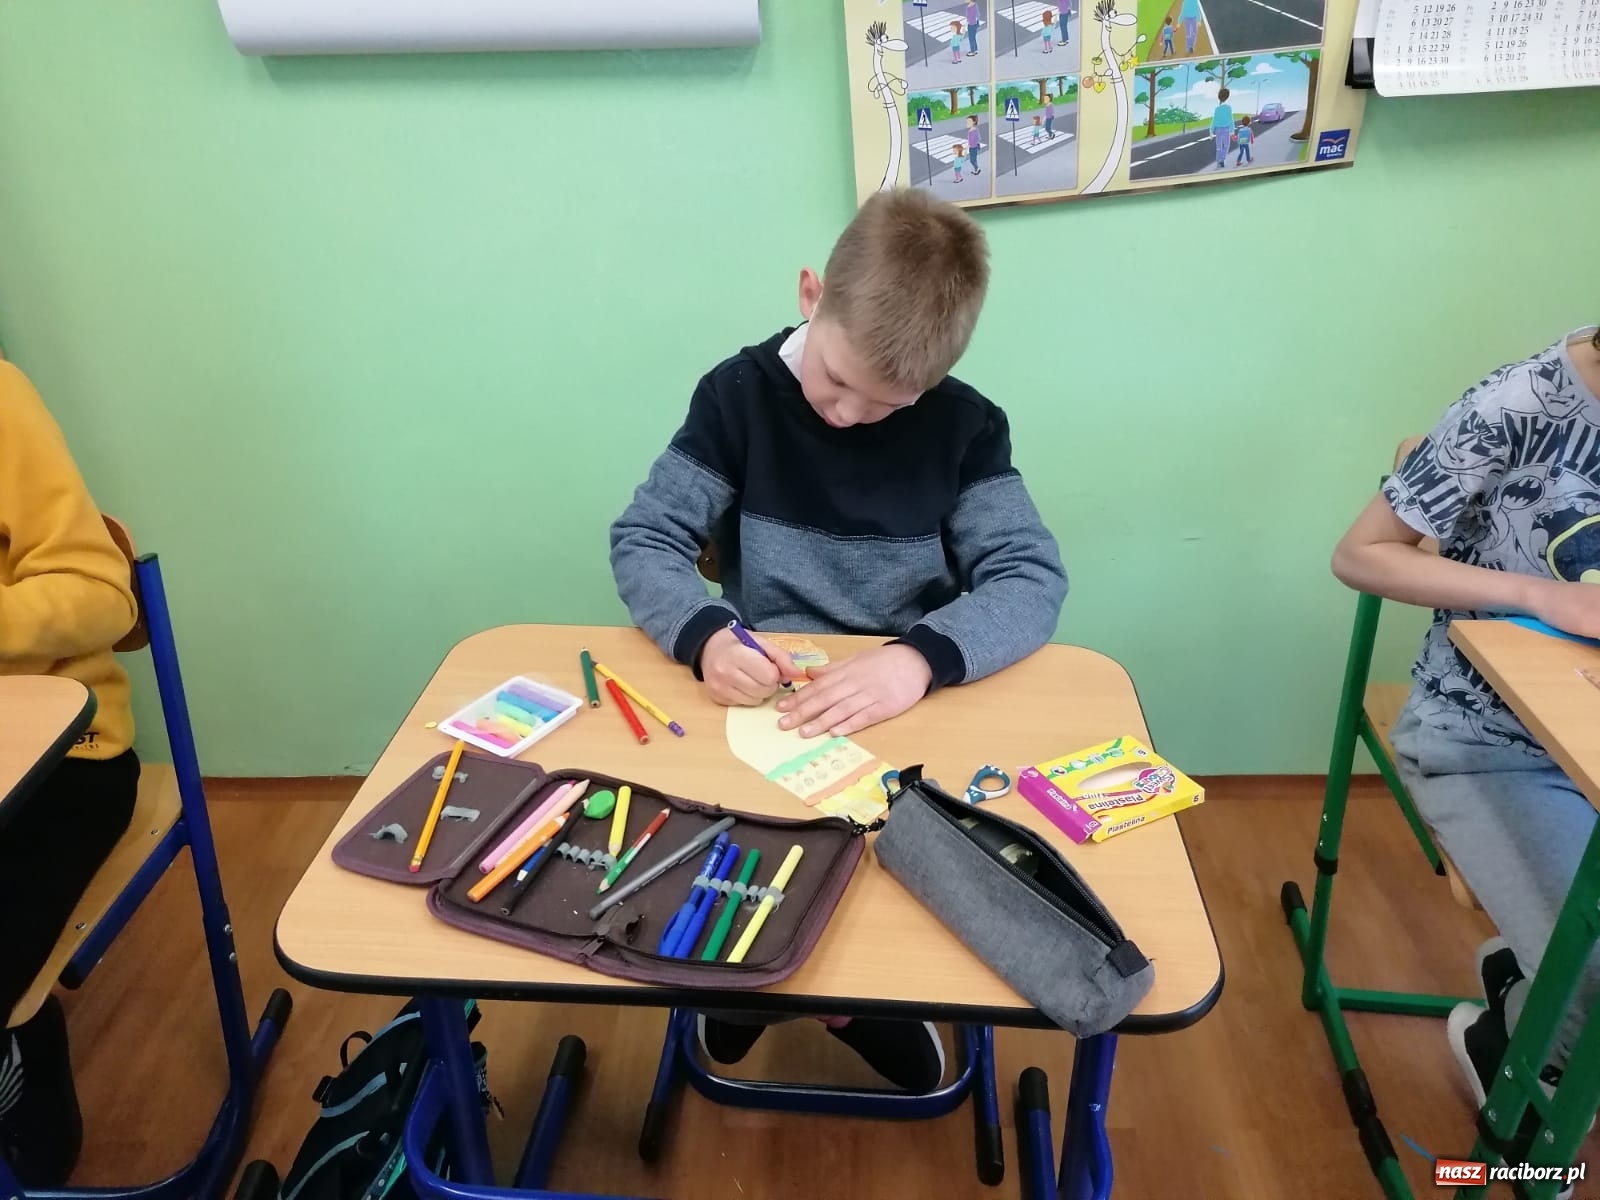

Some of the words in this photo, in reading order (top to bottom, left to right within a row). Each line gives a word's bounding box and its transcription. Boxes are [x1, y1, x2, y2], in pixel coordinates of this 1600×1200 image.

[1319, 144, 1344, 154] mac
[1504, 412, 1600, 486] ATMAN
[1088, 794, 1144, 810] Plastelina
[1107, 816, 1146, 834] Plastelina
